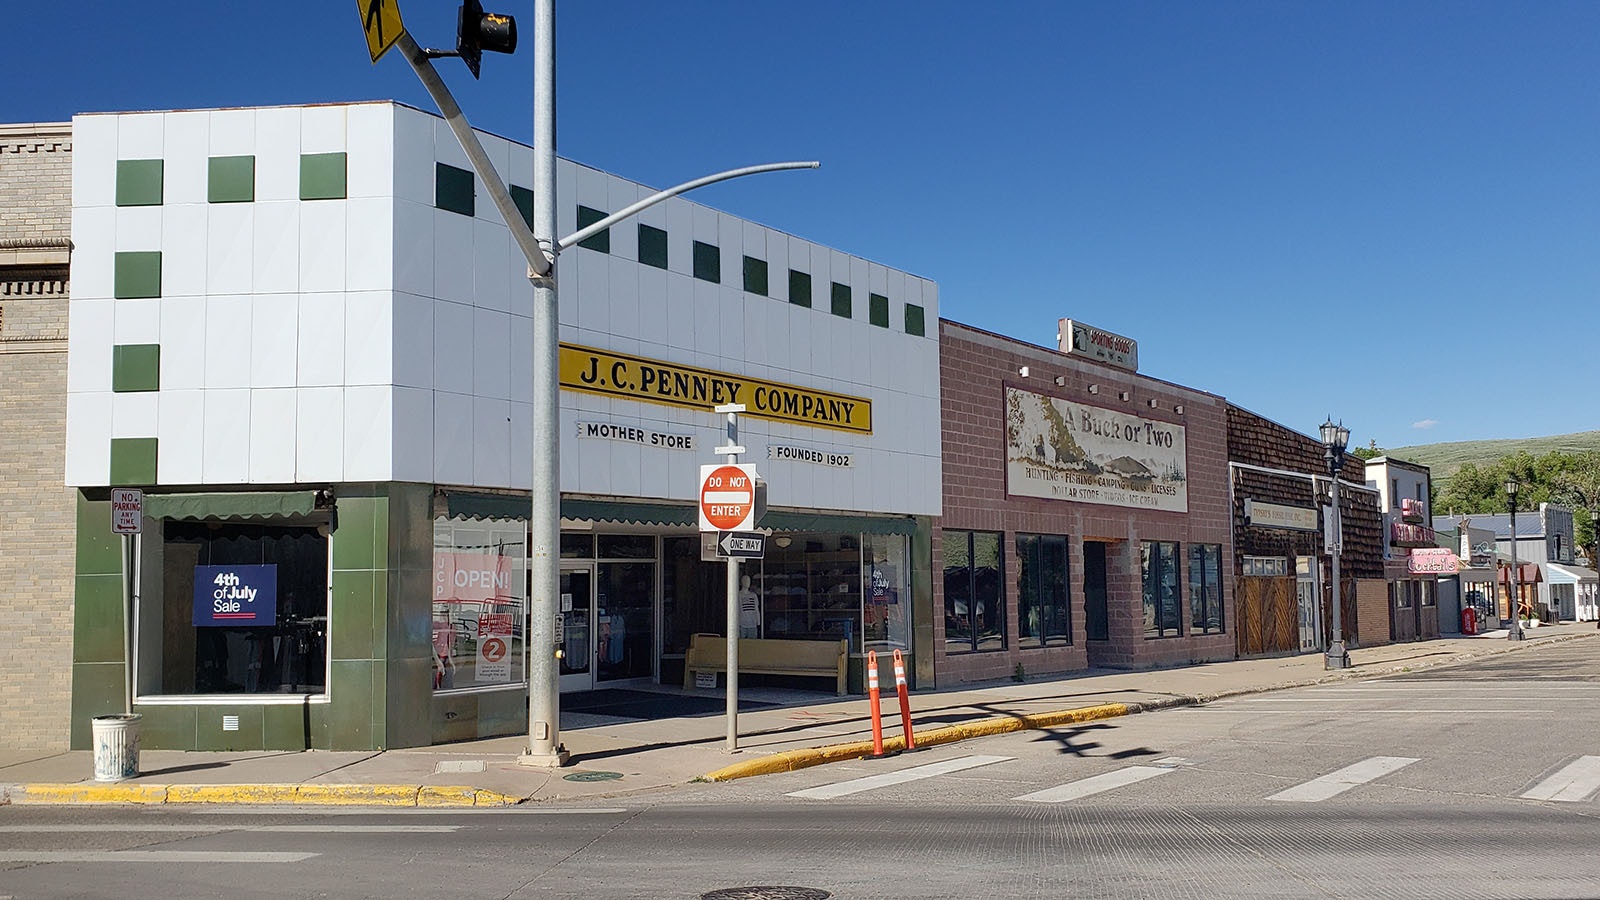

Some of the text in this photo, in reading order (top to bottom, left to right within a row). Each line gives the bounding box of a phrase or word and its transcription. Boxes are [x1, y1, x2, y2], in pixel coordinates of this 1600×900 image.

[755, 387, 854, 424] COMPANY
[1064, 407, 1173, 448] A Buck or Two
[587, 424, 692, 449] MOTHER STORE
[777, 447, 849, 466] FOUNDED 1902
[709, 476, 747, 488] DO NOT
[1026, 467, 1058, 481] HUNTING
[1066, 472, 1092, 485] FISHING
[1098, 477, 1125, 490] CAMPING
[1151, 484, 1177, 496] LICENSES
[121, 494, 133, 502] NO
[113, 502, 140, 511] PARKING
[711, 505, 741, 516] ENTER
[730, 538, 760, 550] ONE WAY
[1408, 557, 1456, 572] Cocktails
[213, 572, 239, 587] 4th
[454, 568, 509, 589] OPEN!
[213, 585, 257, 603] of July
[213, 599, 240, 612] Sale
[488, 641, 500, 659] 2
